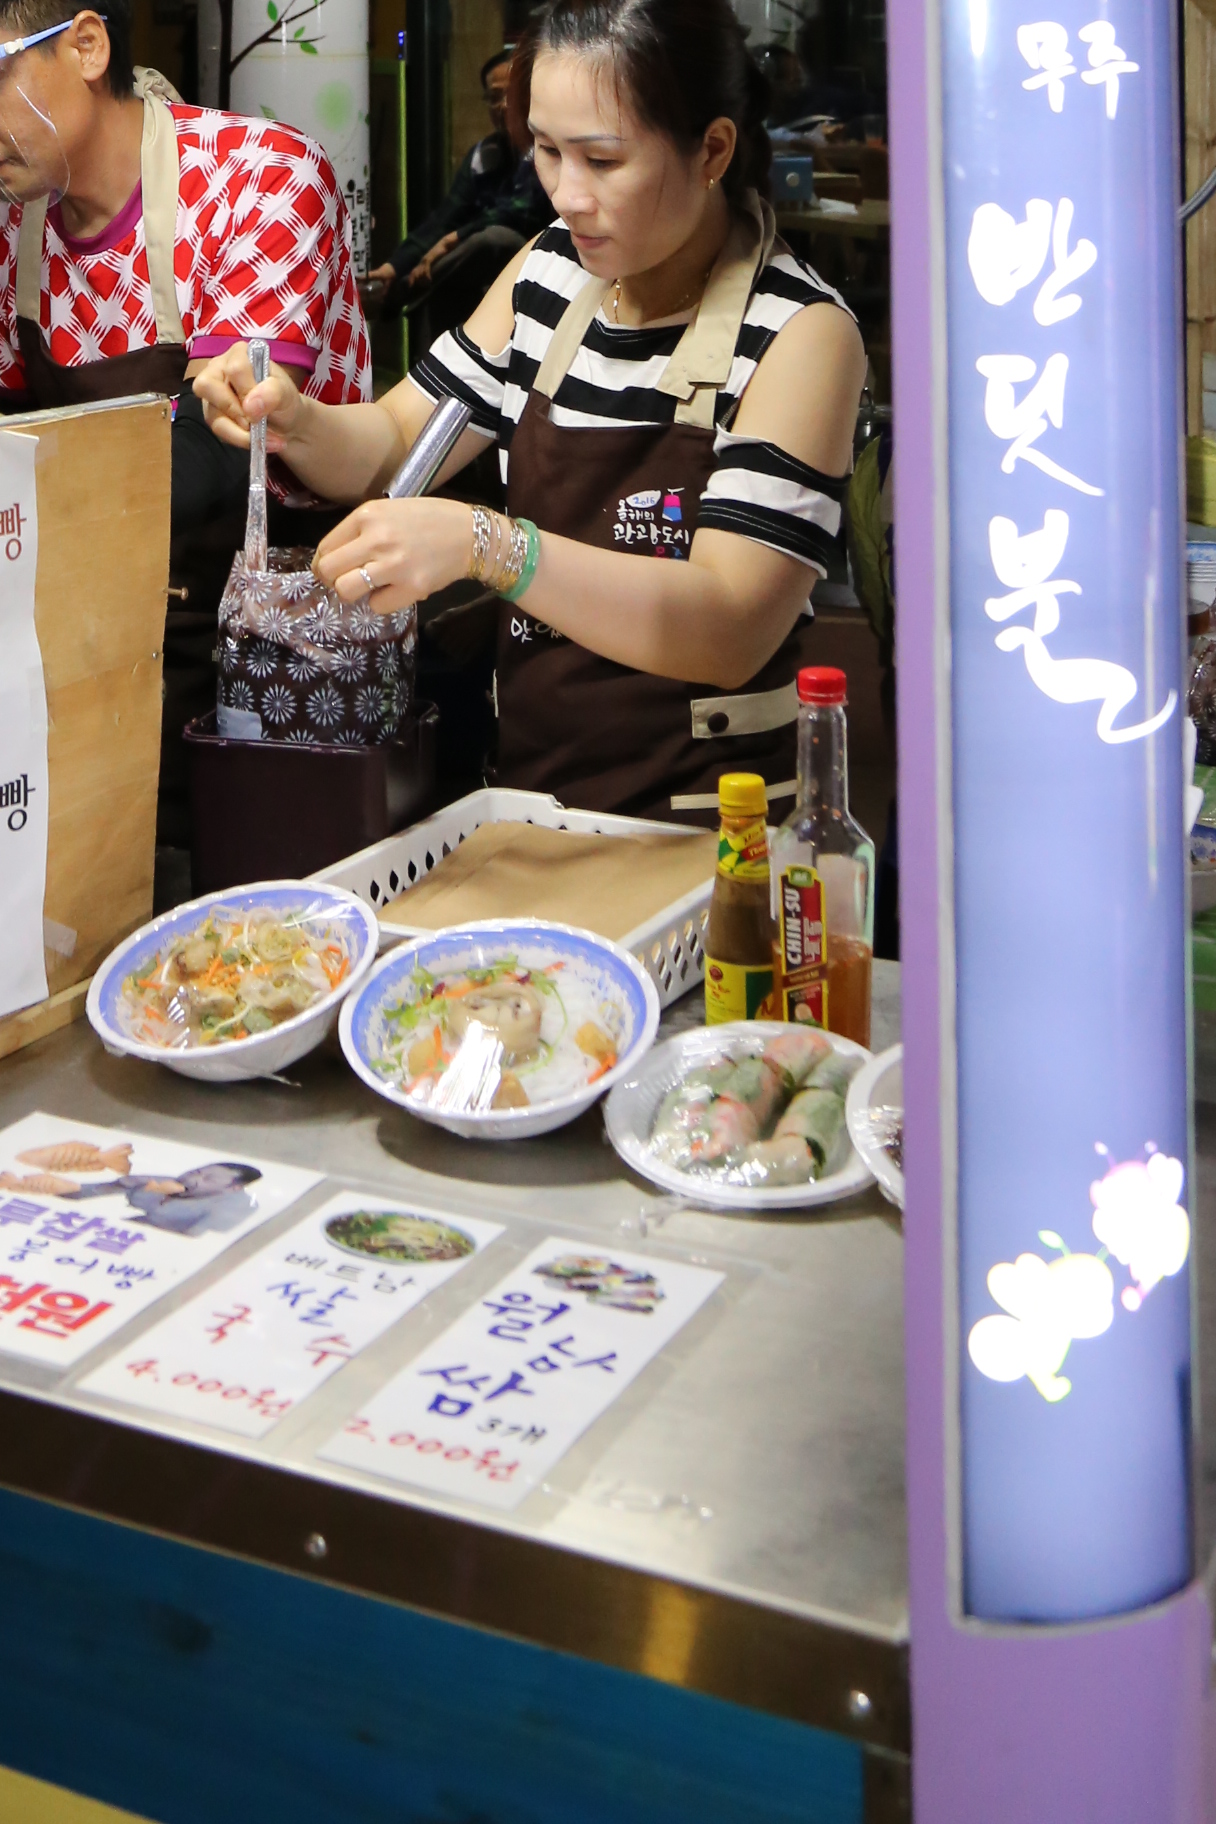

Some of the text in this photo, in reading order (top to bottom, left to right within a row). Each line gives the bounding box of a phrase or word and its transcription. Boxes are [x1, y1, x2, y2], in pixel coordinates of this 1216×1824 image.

[1016, 20, 1140, 119] 무주
[632, 496, 656, 506] 2016
[967, 197, 1178, 745] 반딧불
[612, 521, 690, 545] 관광도시
[616, 499, 655, 522] 올해의
[784, 887, 803, 966] CHIN-SU
[265, 1280, 359, 1328] 쌀
[283, 1253, 417, 1294] 베트남
[482, 1291, 618, 1374] 월남
[416, 1369, 548, 1446] 쌈 3개
